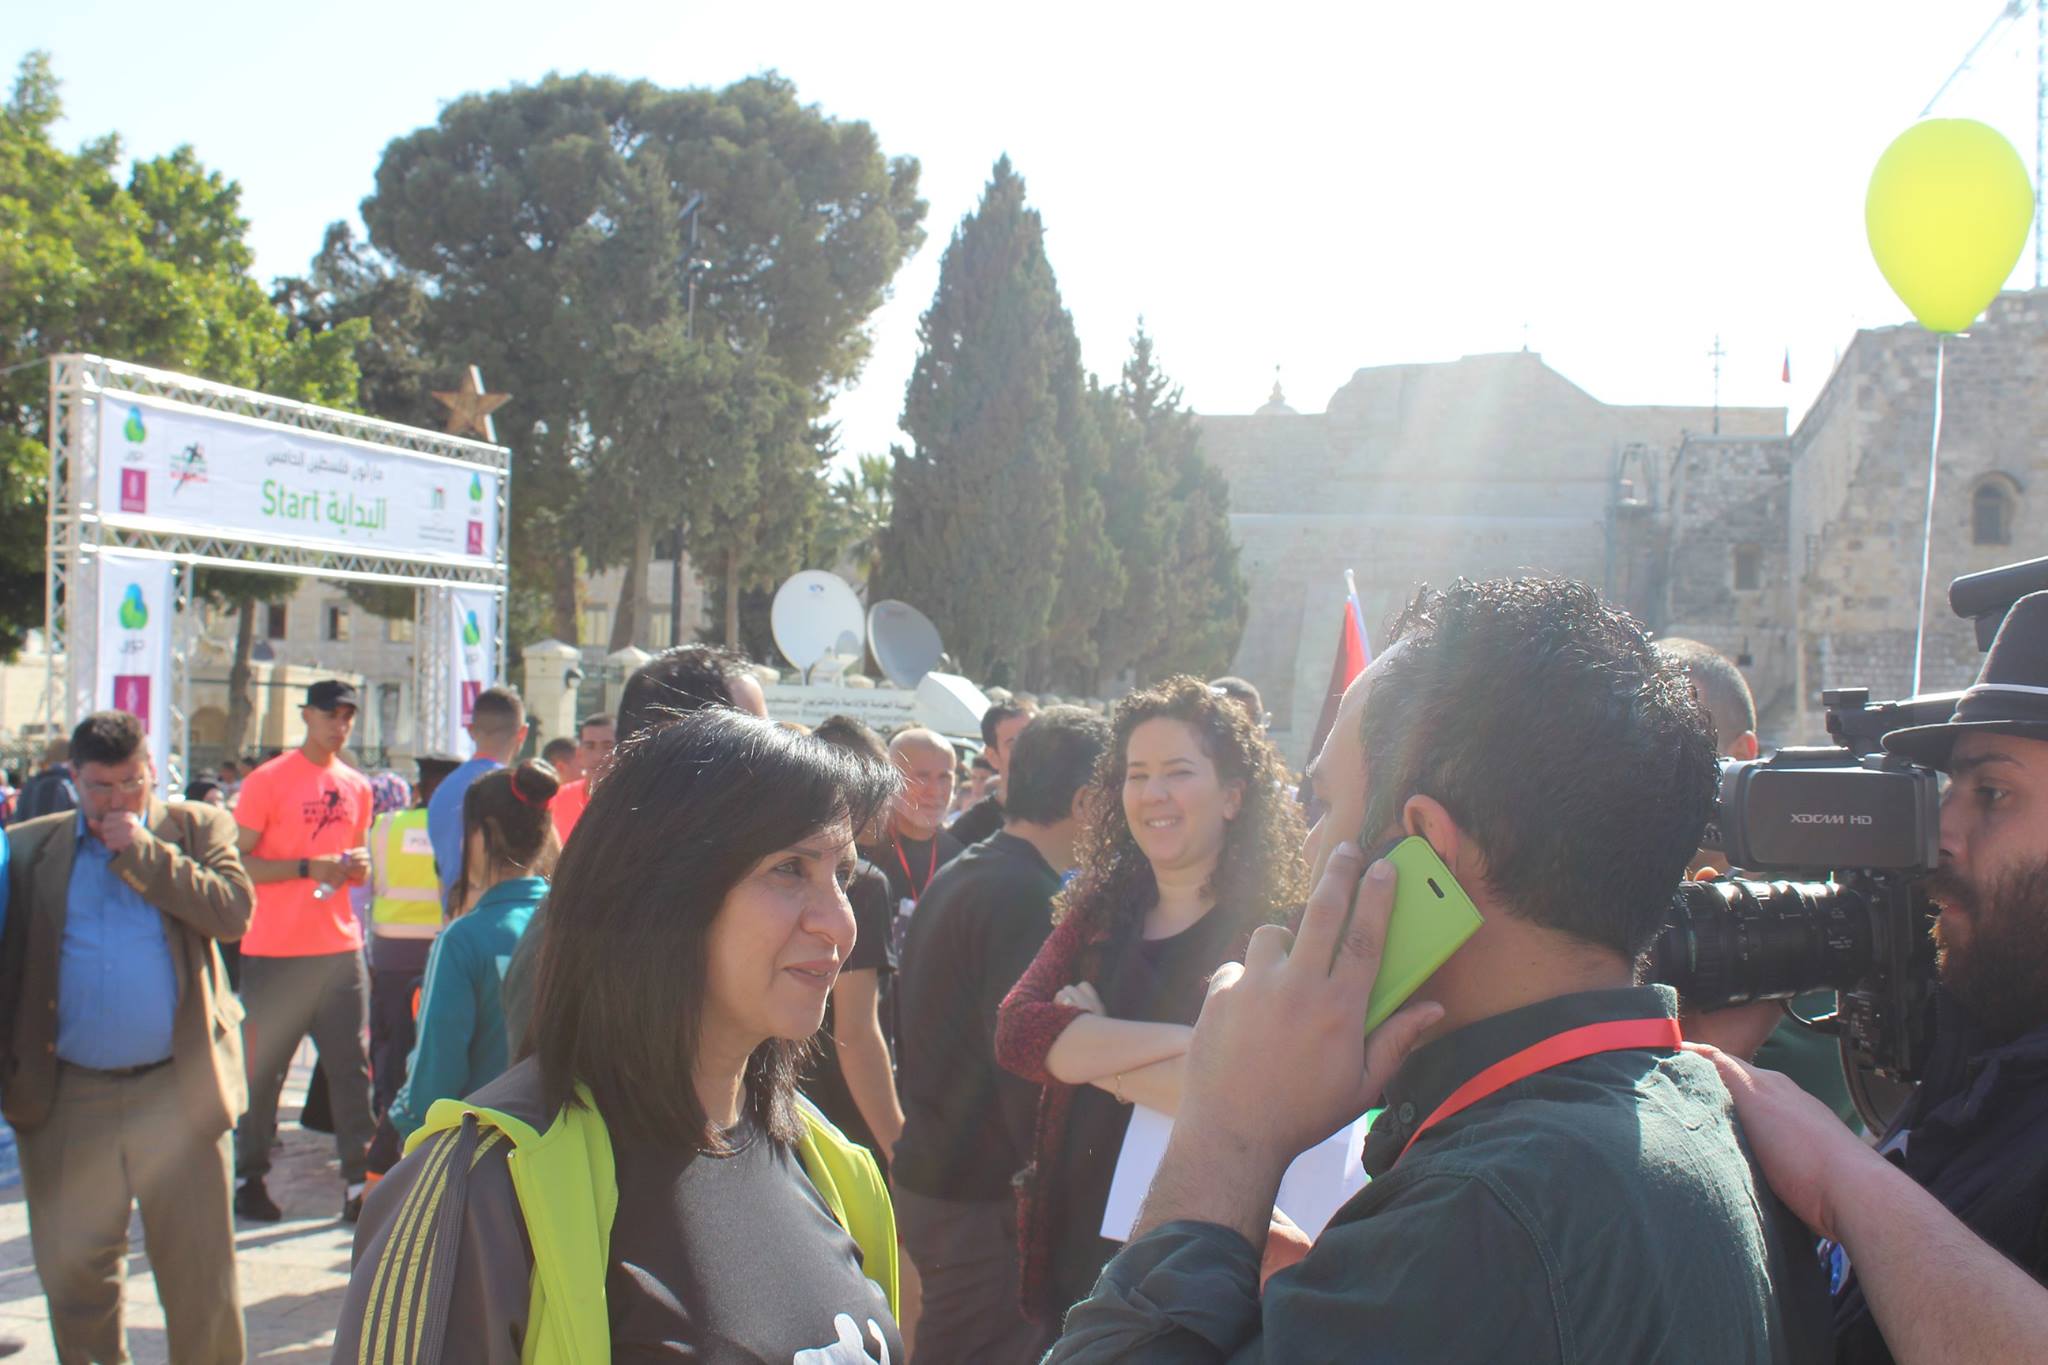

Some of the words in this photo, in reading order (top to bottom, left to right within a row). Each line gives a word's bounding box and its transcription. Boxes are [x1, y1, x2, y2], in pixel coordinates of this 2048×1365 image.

[260, 478, 319, 522] Start
[325, 488, 386, 537] البداية
[1791, 814, 1844, 825] XDCAM
[1850, 815, 1872, 825] HD
